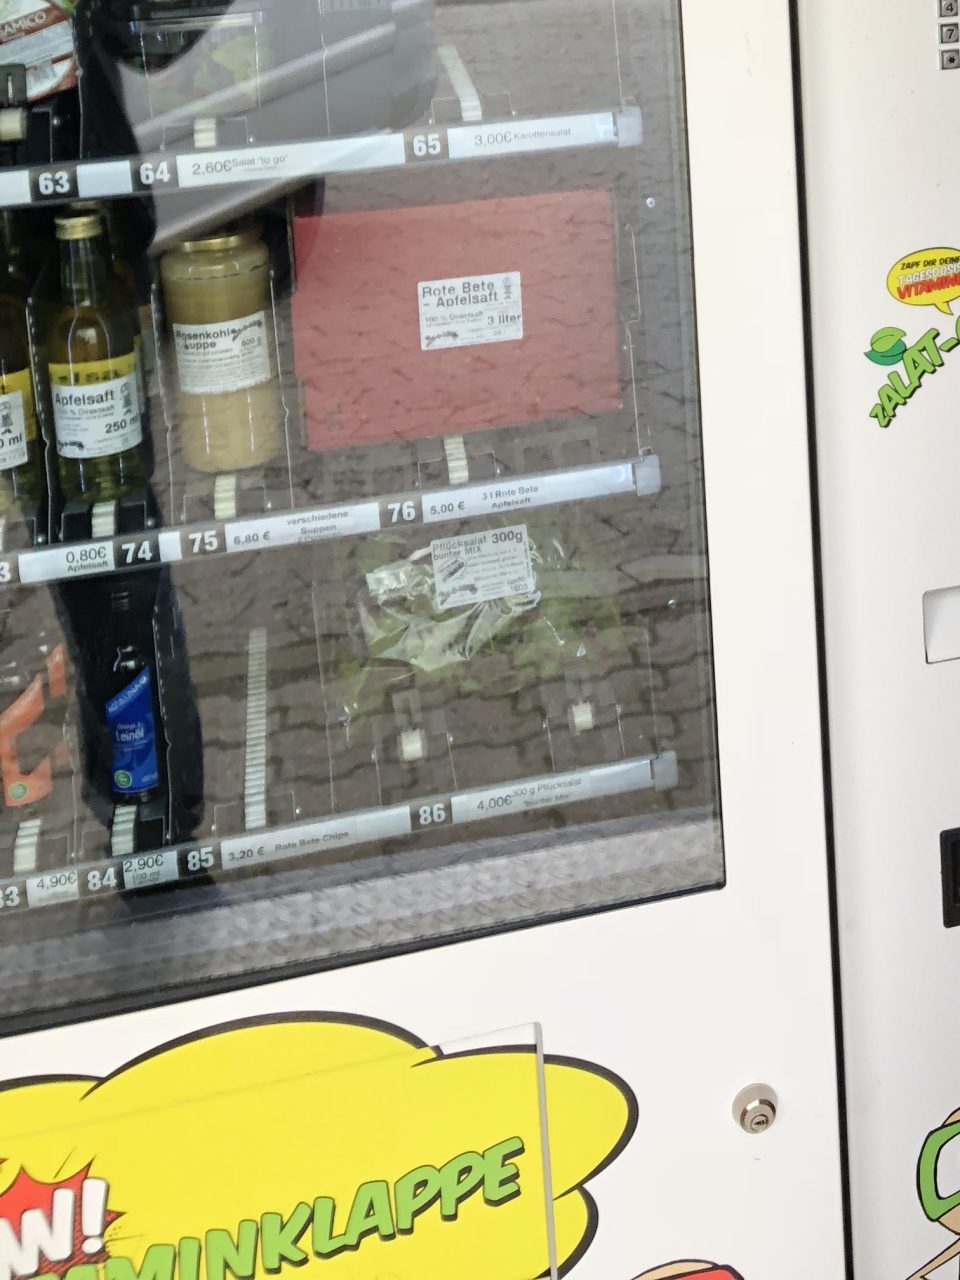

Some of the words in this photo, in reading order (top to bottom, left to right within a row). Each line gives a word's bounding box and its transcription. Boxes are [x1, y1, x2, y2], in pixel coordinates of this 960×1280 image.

[946, 3, 953, 13] 4
[947, 29, 954, 39] 7
[413, 134, 440, 156] 65
[474, 132, 512, 147] 3,00€
[140, 161, 170, 185] 64
[39, 171, 70, 194] 63
[901, 260, 920, 270] ZAPF
[923, 258, 937, 267] DIR
[422, 285, 455, 298] Rote
[462, 280, 494, 293] Bete
[436, 290, 498, 308] Apfelsaft
[487, 316, 494, 325] 3
[55, 389, 114, 406] Apfelsaft
[105, 419, 127, 433] 250
[9, 433, 22, 446] ml
[387, 501, 416, 521] 76
[430, 503, 454, 516] 5,00
[458, 501, 465, 511] €
[495, 489, 516, 498] Rote
[519, 486, 538, 494] Bete
[189, 530, 218, 553] 75
[233, 533, 259, 545] 6,80
[287, 511, 348, 525] verschiedene
[491, 531, 523, 544] 300g
[66, 546, 107, 564] 0,80€
[122, 540, 152, 564] 74
[418, 803, 446, 825] 86
[477, 794, 513, 811] 4,00€
[187, 847, 214, 870] 85
[228, 849, 253, 862] 3,20
[37, 871, 77, 890] 4,90€
[87, 867, 117, 891] 84
[125, 854, 164, 872] 2,90€
